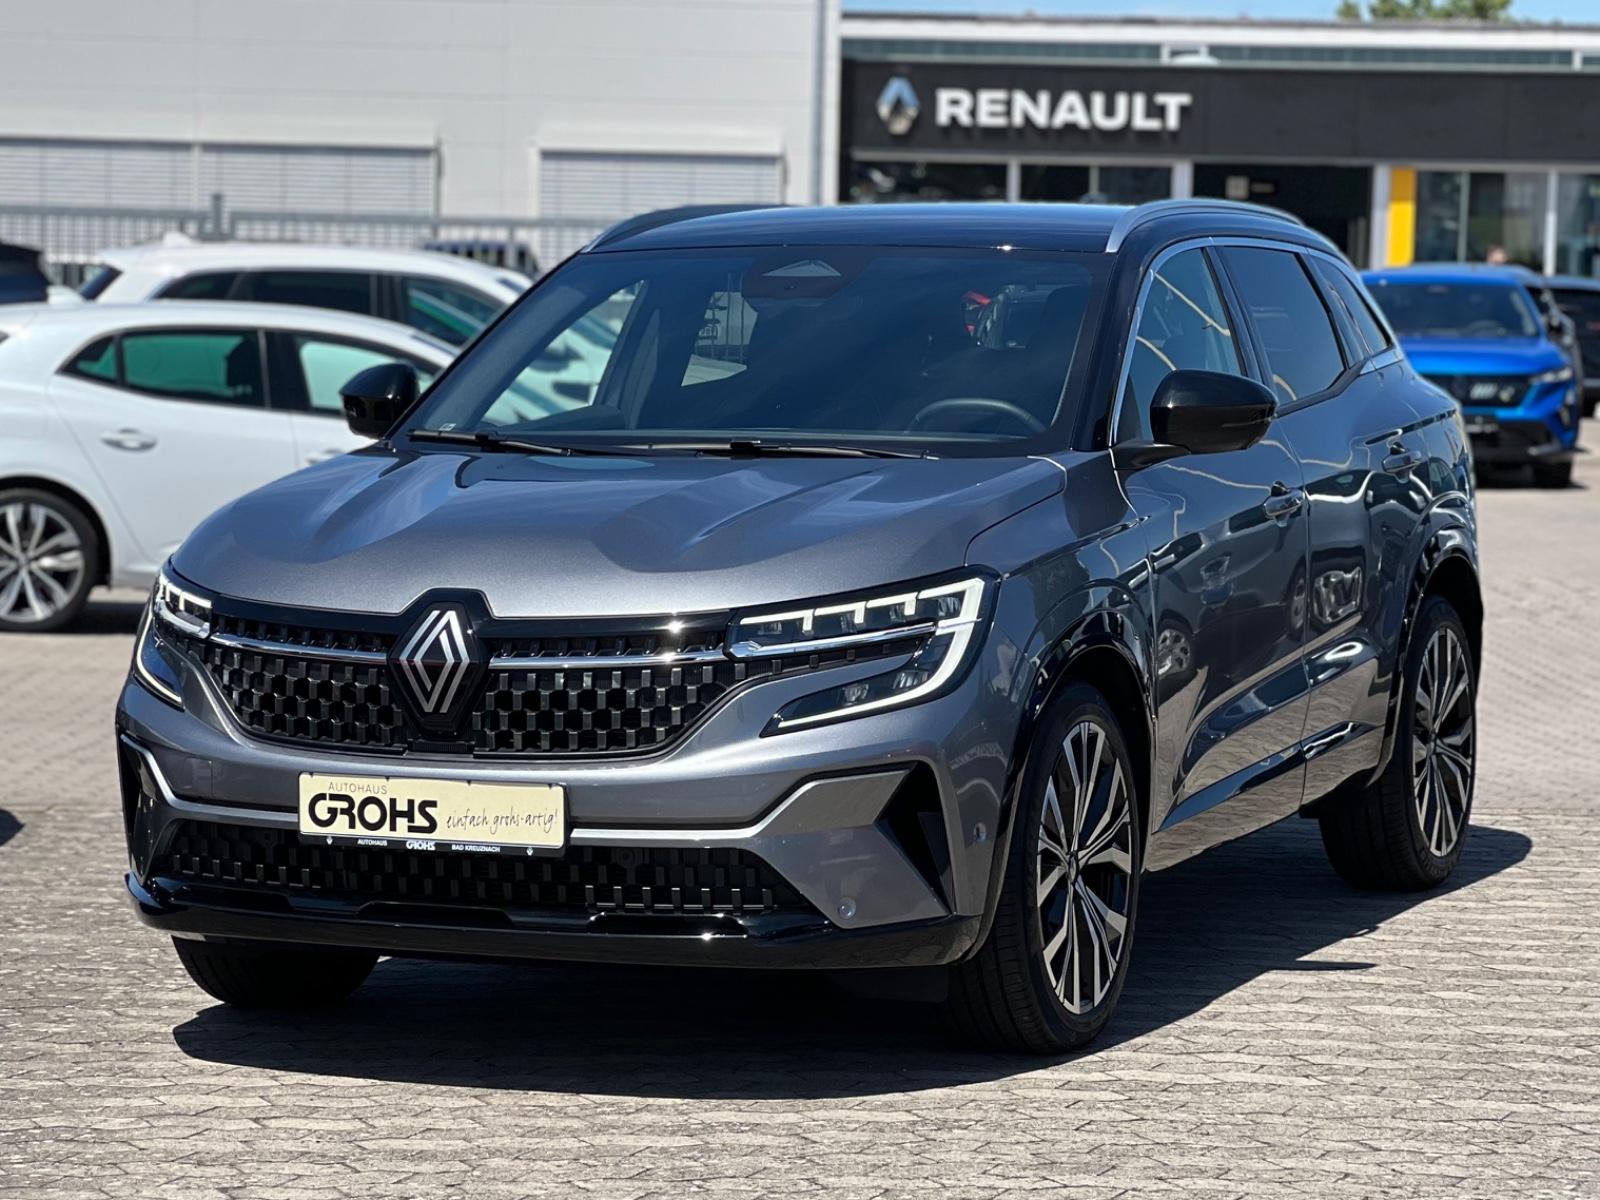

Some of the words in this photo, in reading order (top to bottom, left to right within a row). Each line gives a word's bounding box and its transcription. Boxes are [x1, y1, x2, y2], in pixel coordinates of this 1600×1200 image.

[935, 88, 1193, 131] RENAULT
[328, 782, 388, 795] AUTOHAUS
[308, 792, 438, 834] GROHS
[446, 807, 488, 830] einfach
[489, 805, 559, 835] grohs-artig!
[357, 839, 388, 847] AUTOHAUS
[406, 840, 436, 851] GROHS
[465, 845, 501, 853] KREUZNACH
